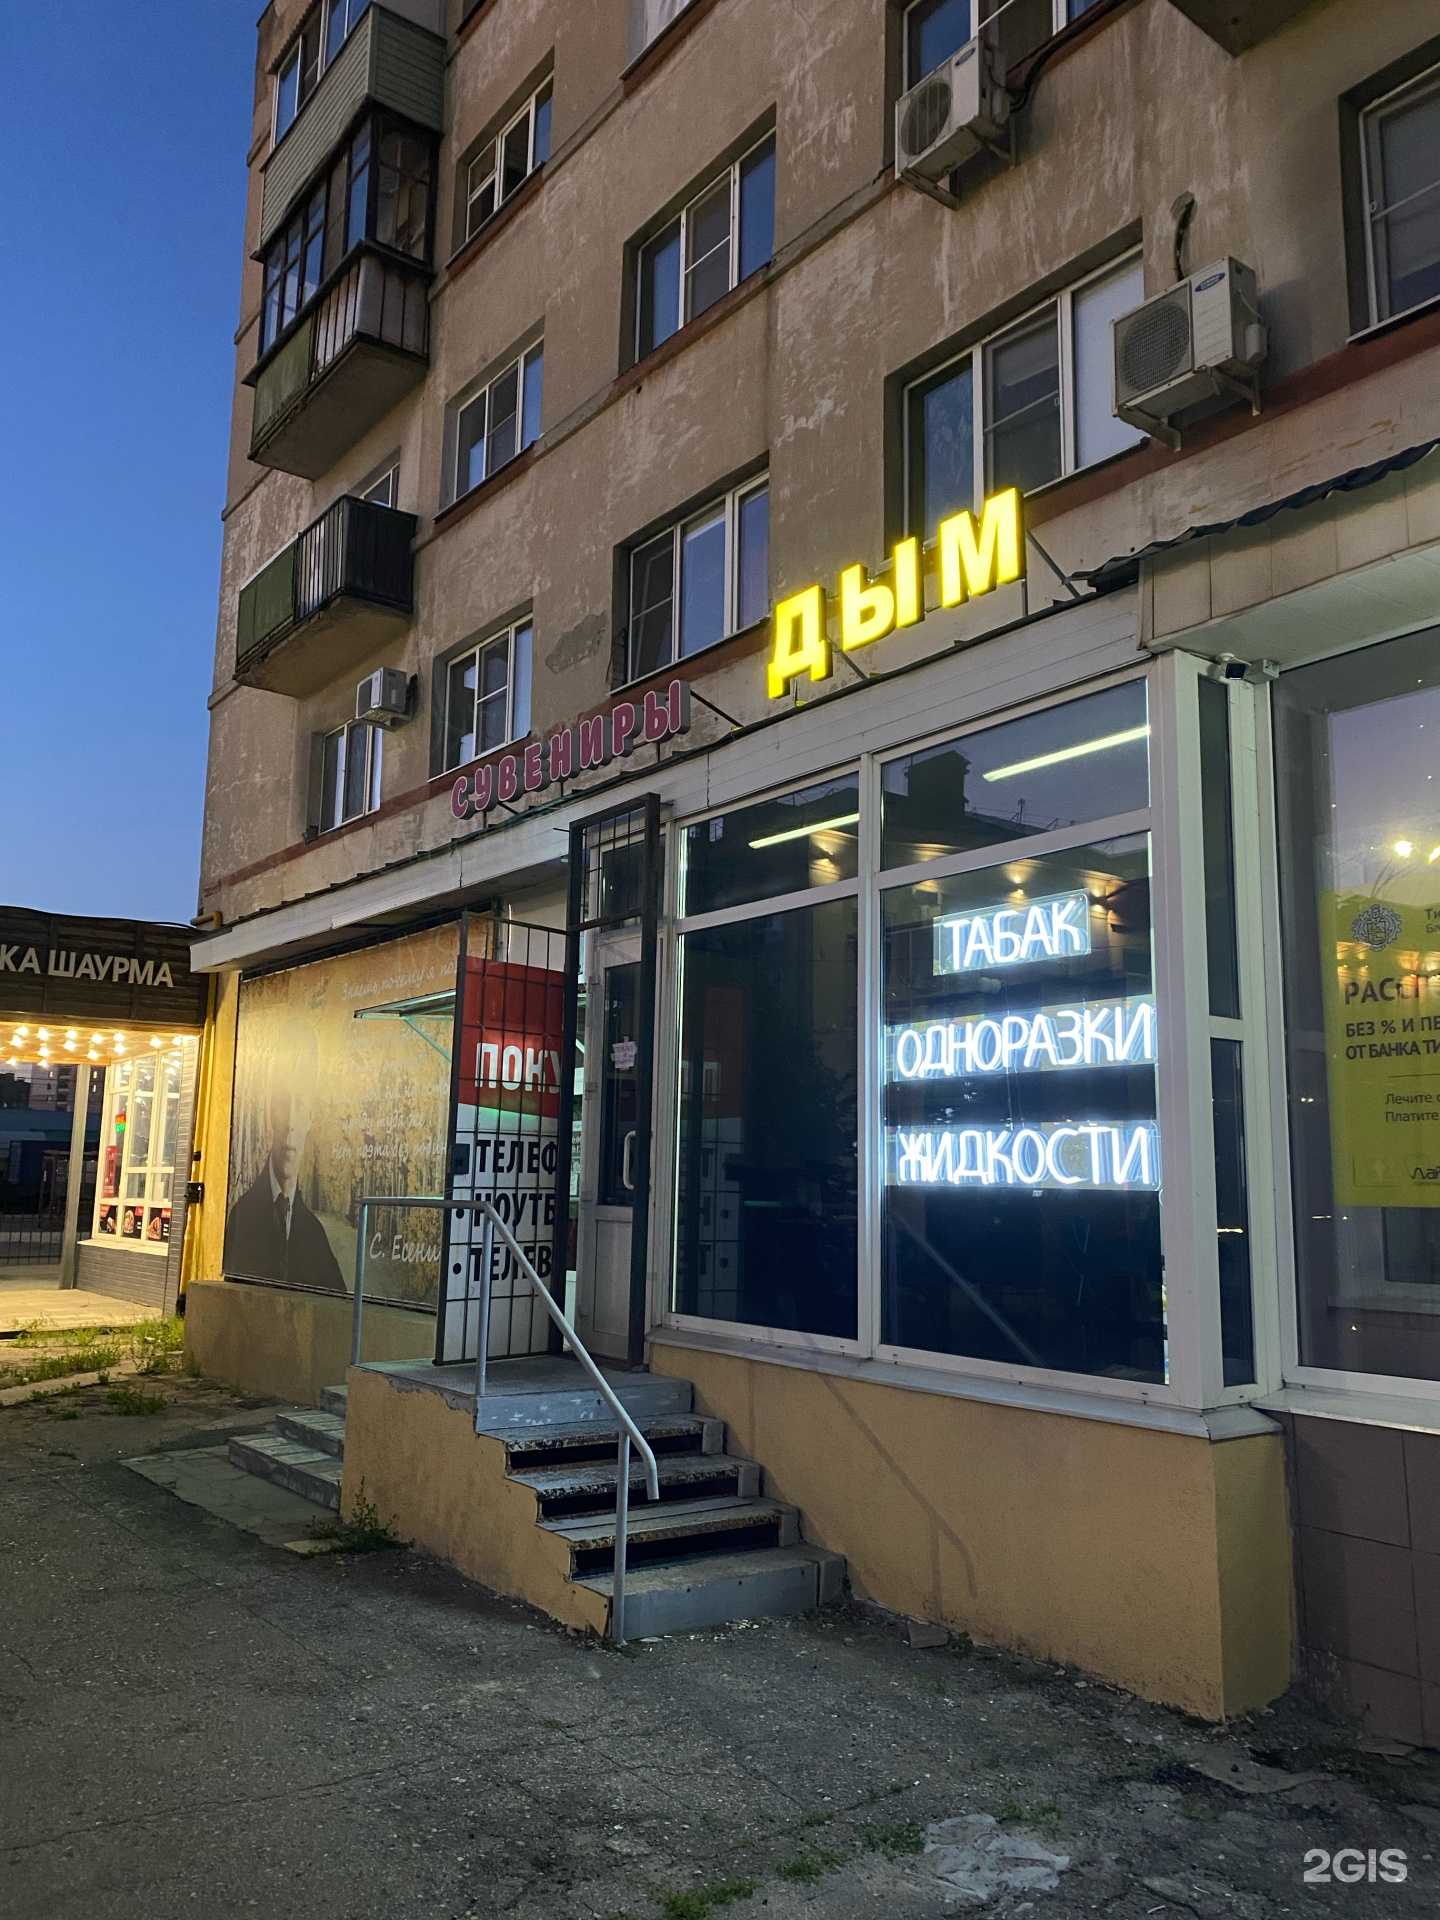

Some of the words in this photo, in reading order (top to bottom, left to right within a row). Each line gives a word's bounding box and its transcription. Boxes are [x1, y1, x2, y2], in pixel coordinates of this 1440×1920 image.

[767, 486, 1027, 699] ДЫМ
[450, 678, 687, 820] СУВЕНИРЫ
[943, 899, 1082, 971] ТАБАК
[0, 944, 41, 975] КА
[48, 950, 175, 988] ШАУРМА
[896, 1002, 1153, 1078] ОДНОРАЗКИ
[1346, 1021, 1376, 1038] БЕЗ
[1381, 1019, 1397, 1035] %
[1402, 1018, 1414, 1033] И
[1346, 1044, 1367, 1060] ОТ
[1369, 1040, 1421, 1058] БАНКА
[1385, 1093, 1433, 1105] Лечите
[1385, 1110, 1440, 1123] Платите
[899, 1125, 1152, 1185] ЖИДКОСТИ
[370, 1232, 385, 1259] С.
